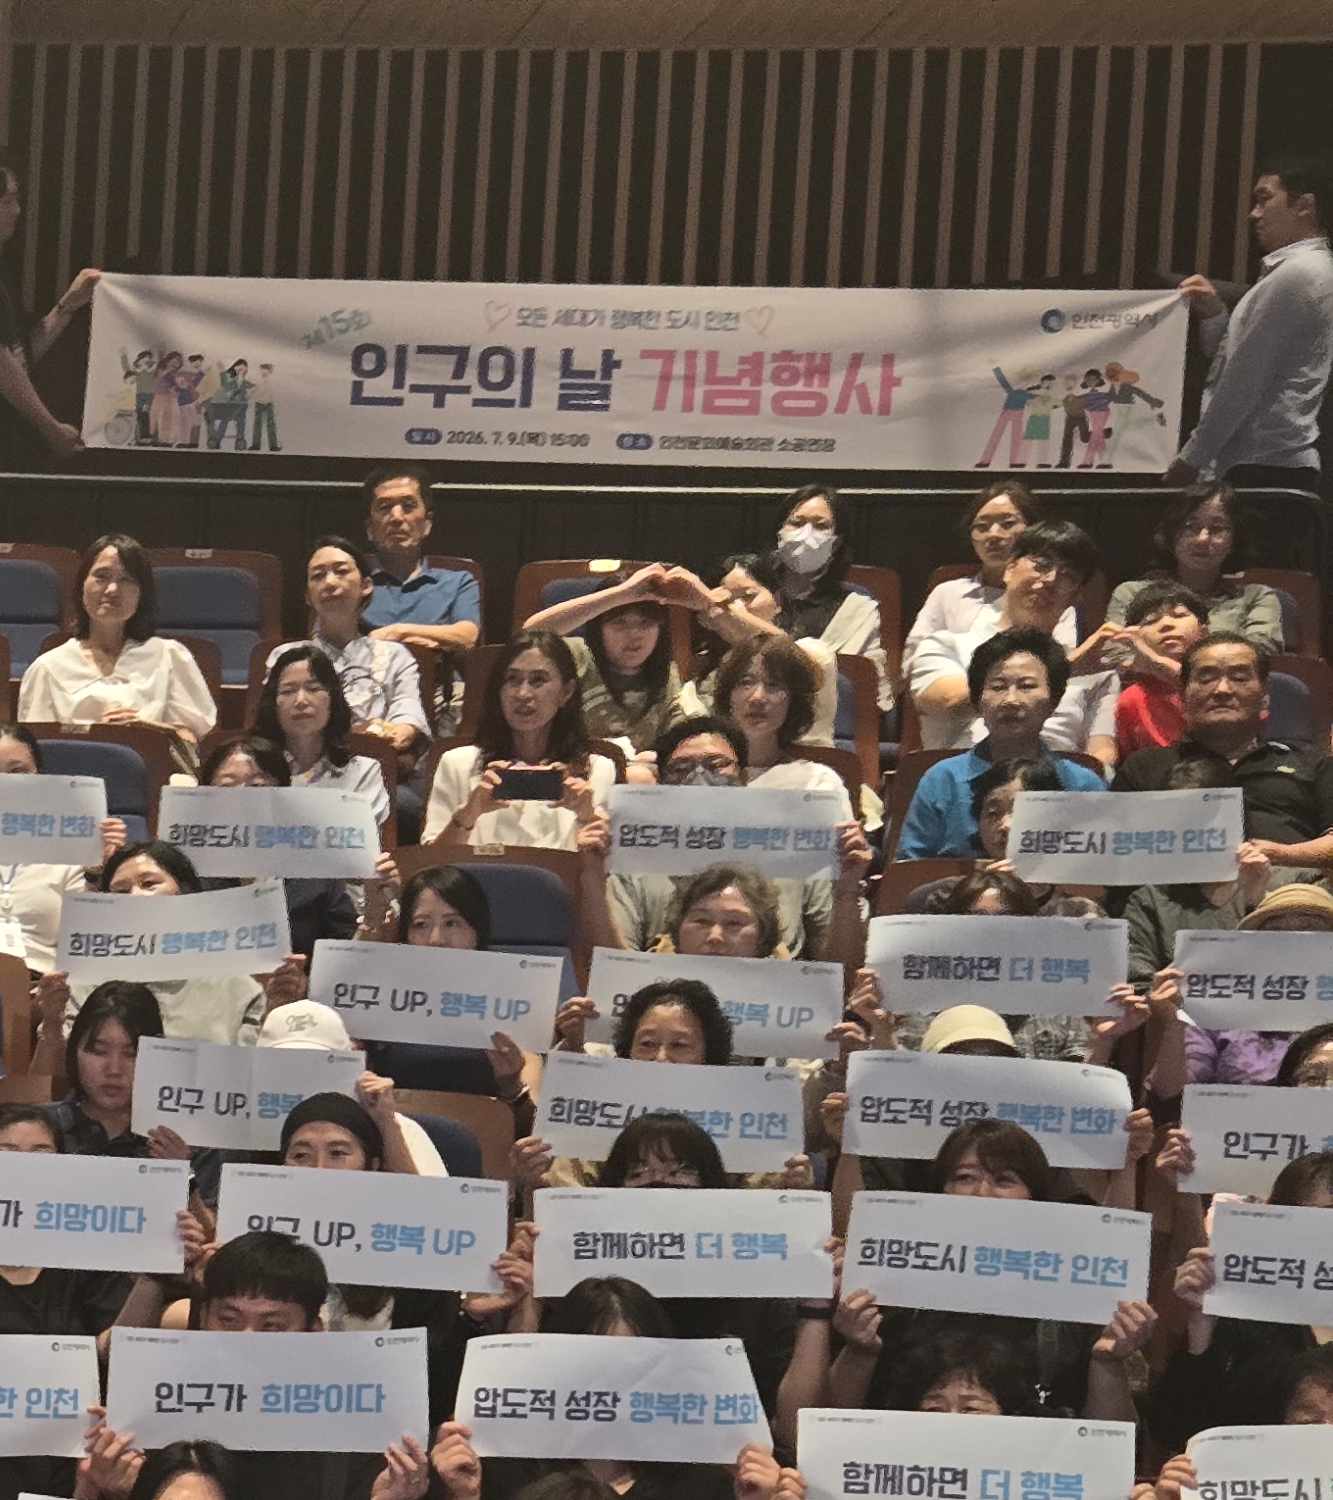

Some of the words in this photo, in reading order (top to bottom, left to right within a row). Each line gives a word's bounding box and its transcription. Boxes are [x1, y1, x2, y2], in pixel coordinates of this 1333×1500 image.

[350, 342, 536, 409] 인구의
[557, 348, 622, 412] 날
[639, 348, 902, 417] 기념행사
[1017, 829, 1107, 855] 희망도시
[331, 982, 380, 1015] 인구
[389, 988, 433, 1017] UP,
[440, 991, 487, 1019] 행복
[493, 998, 530, 1021] UP
[1223, 1130, 1308, 1161] 인구가
[34, 1201, 146, 1234] 희망이다
[572, 1231, 685, 1260] 함께하면
[695, 1232, 723, 1259] 더
[732, 1232, 788, 1260] 행복
[857, 1237, 967, 1274] 희망도시
[974, 1245, 1063, 1281] 행복한
[1070, 1254, 1128, 1288] 인천
[1223, 1254, 1305, 1287] 압도적
[25, 1387, 78, 1419] 인천
[842, 1461, 968, 1500] 함께하면
[980, 1469, 1010, 1500] 더
